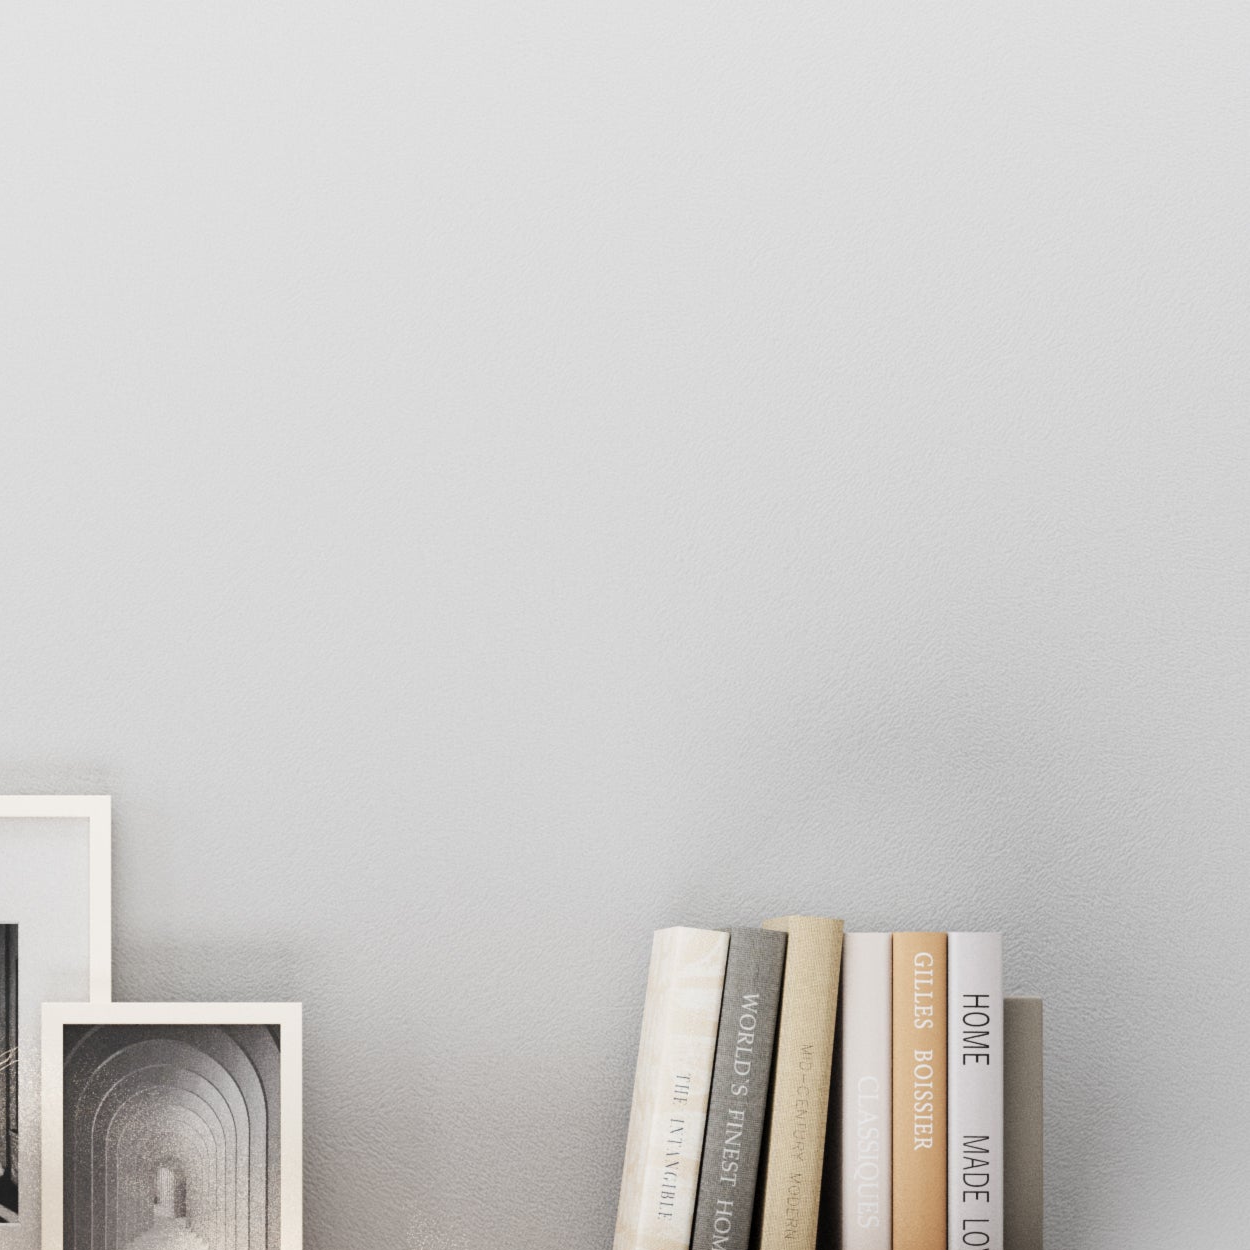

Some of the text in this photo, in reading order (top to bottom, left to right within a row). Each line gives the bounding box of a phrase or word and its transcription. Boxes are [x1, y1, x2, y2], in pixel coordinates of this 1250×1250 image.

[731, 993, 760, 1096] WORLD'S
[914, 952, 933, 1150] GILLES BOISSIER
[963, 994, 989, 1066] HOME
[658, 1072, 692, 1220] THE INTANGIBLE
[720, 1108, 745, 1187] FINEST
[854, 1076, 880, 1228] CLASSIQUES
[963, 1136, 989, 1203] MADE
